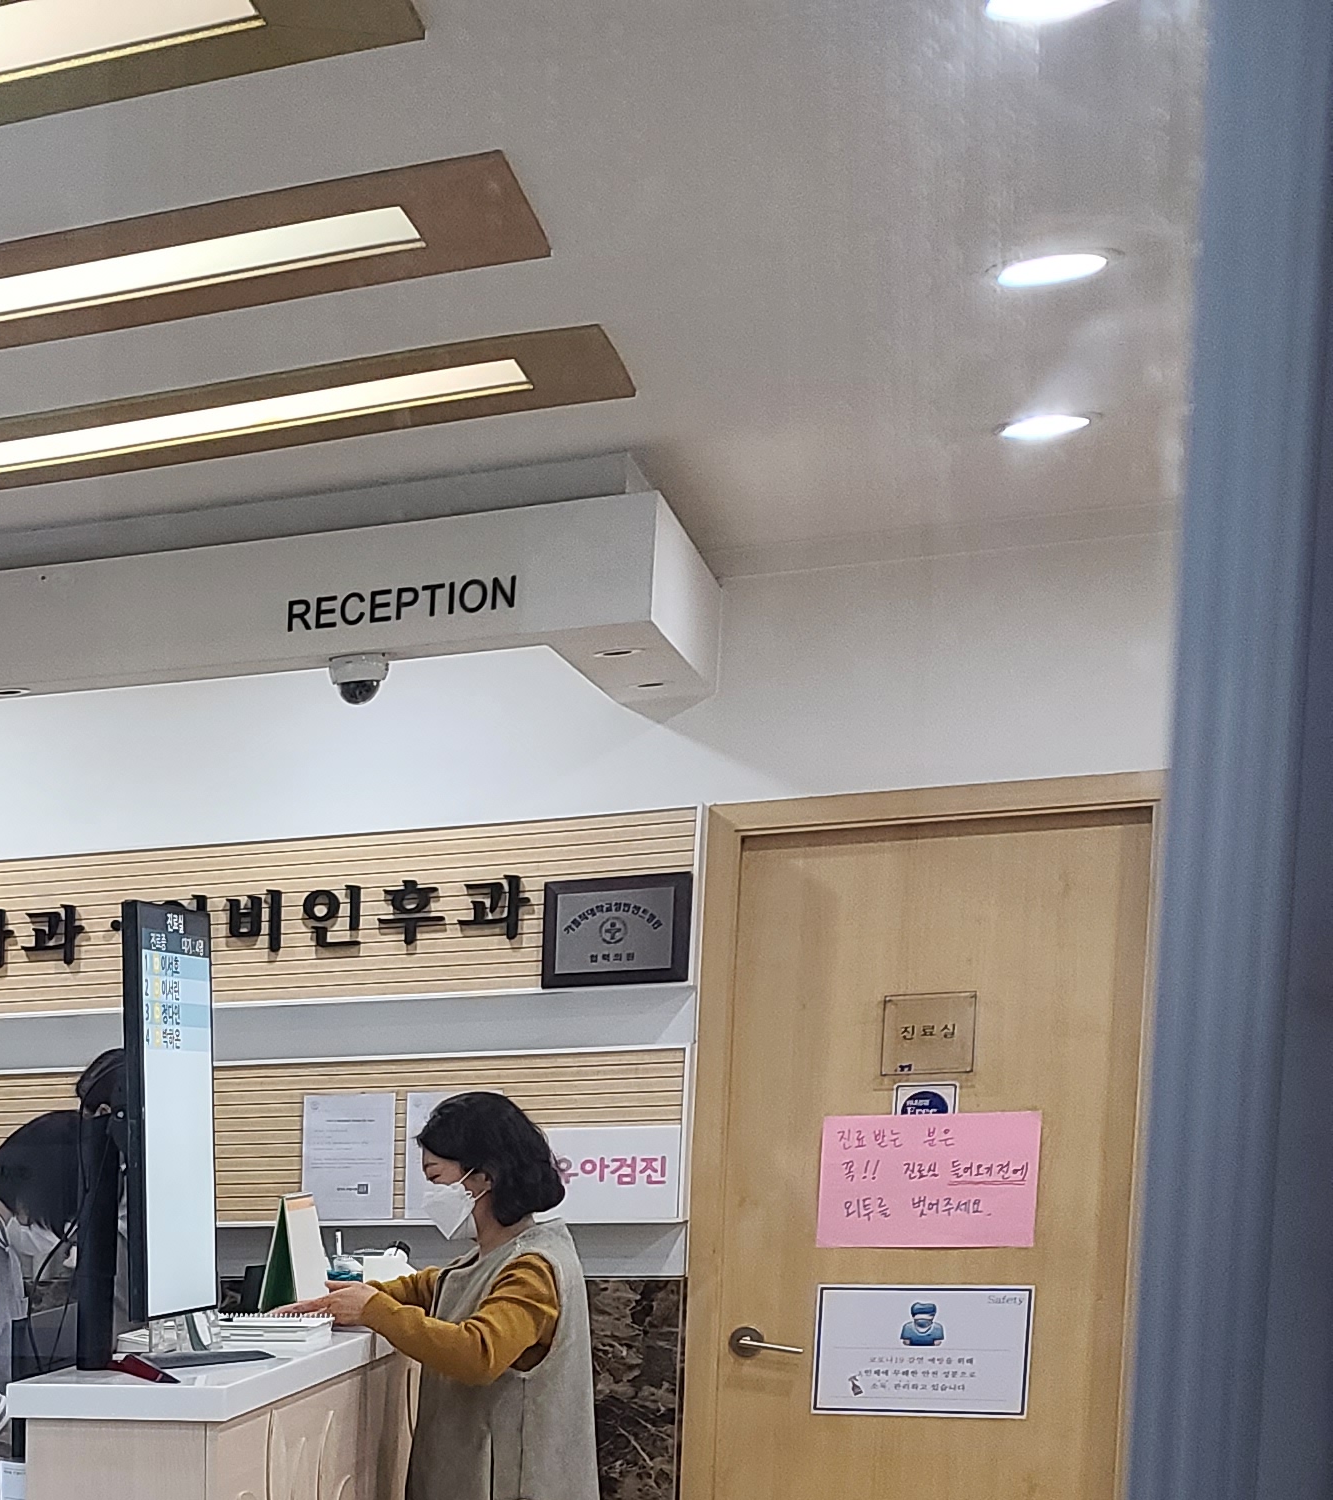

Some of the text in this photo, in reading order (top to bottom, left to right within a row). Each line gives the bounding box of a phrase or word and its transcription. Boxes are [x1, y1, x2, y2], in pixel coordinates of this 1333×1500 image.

[287, 575, 517, 632] RECEPTION
[162, 873, 531, 952] 비인후과
[900, 1023, 956, 1040] 진료실
[923, 1127, 955, 1147] 분은
[843, 1197, 891, 1221] 외투를
[987, 1294, 1025, 1306] Safety
